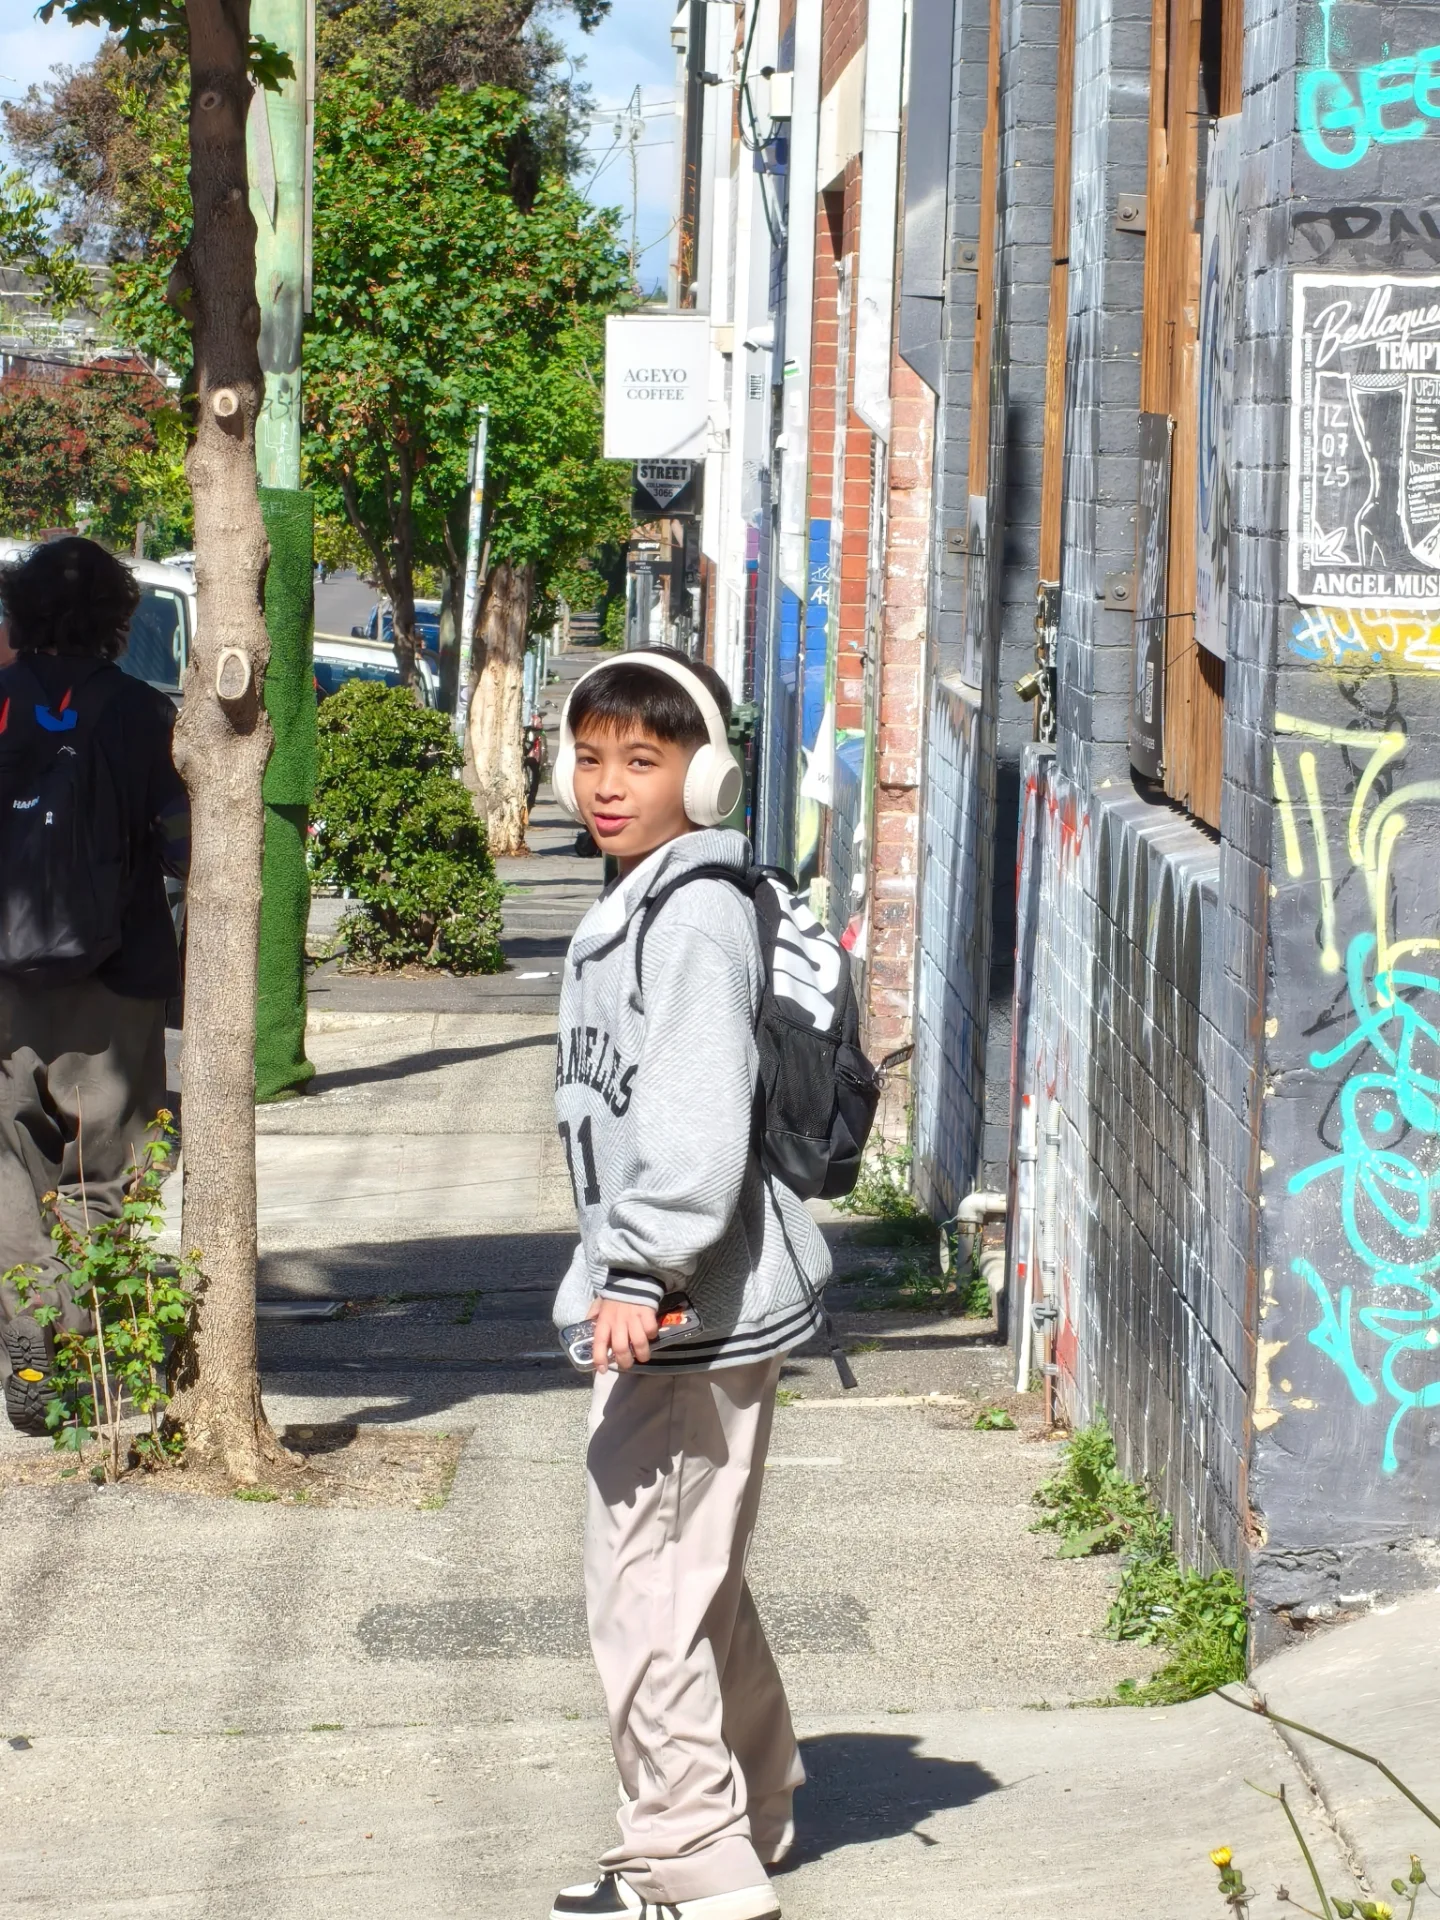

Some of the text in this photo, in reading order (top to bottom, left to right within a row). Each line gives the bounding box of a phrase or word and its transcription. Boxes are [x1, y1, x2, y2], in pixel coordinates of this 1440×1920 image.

[624, 368, 687, 383] AGEYO
[627, 388, 684, 400] COFFEE
[1414, 379, 1440, 396] UPST
[1303, 411, 1312, 430] SALSA
[1322, 433, 1348, 458] 07
[640, 465, 688, 480] STREET
[1322, 463, 1350, 487] 25
[1409, 460, 1440, 475] DOWNST
[653, 488, 674, 498] 3066
[1312, 573, 1440, 597] ANGEL MUS
